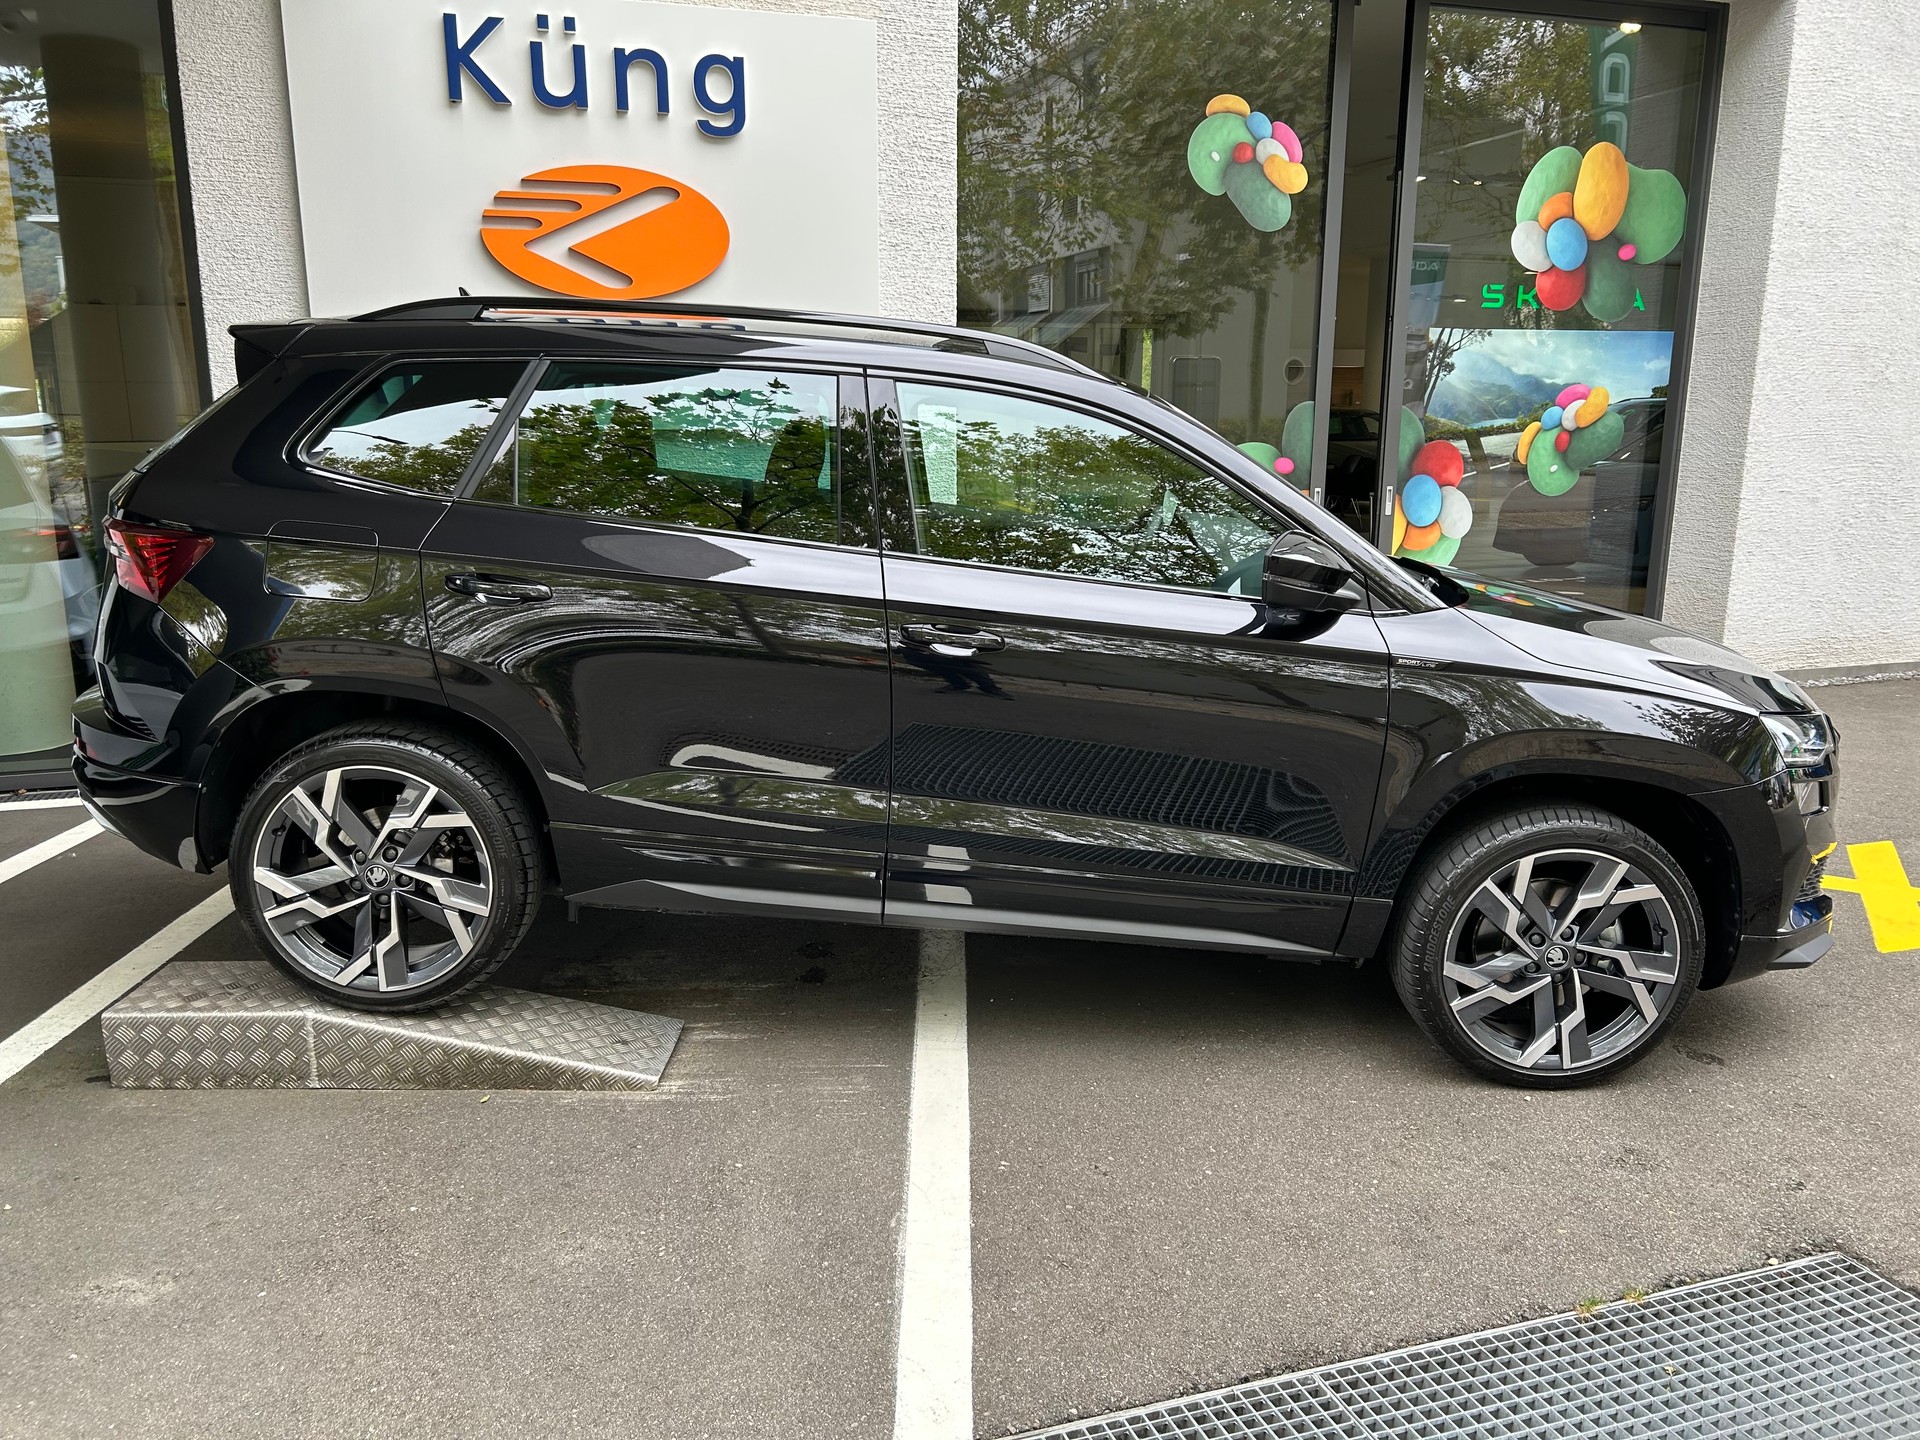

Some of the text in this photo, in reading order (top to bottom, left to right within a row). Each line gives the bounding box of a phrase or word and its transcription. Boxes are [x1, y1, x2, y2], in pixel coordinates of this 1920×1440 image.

[443, 12, 746, 137] Küng
[1481, 283, 1646, 311] SKA
[1423, 894, 1456, 973] BRIDGESTONE
